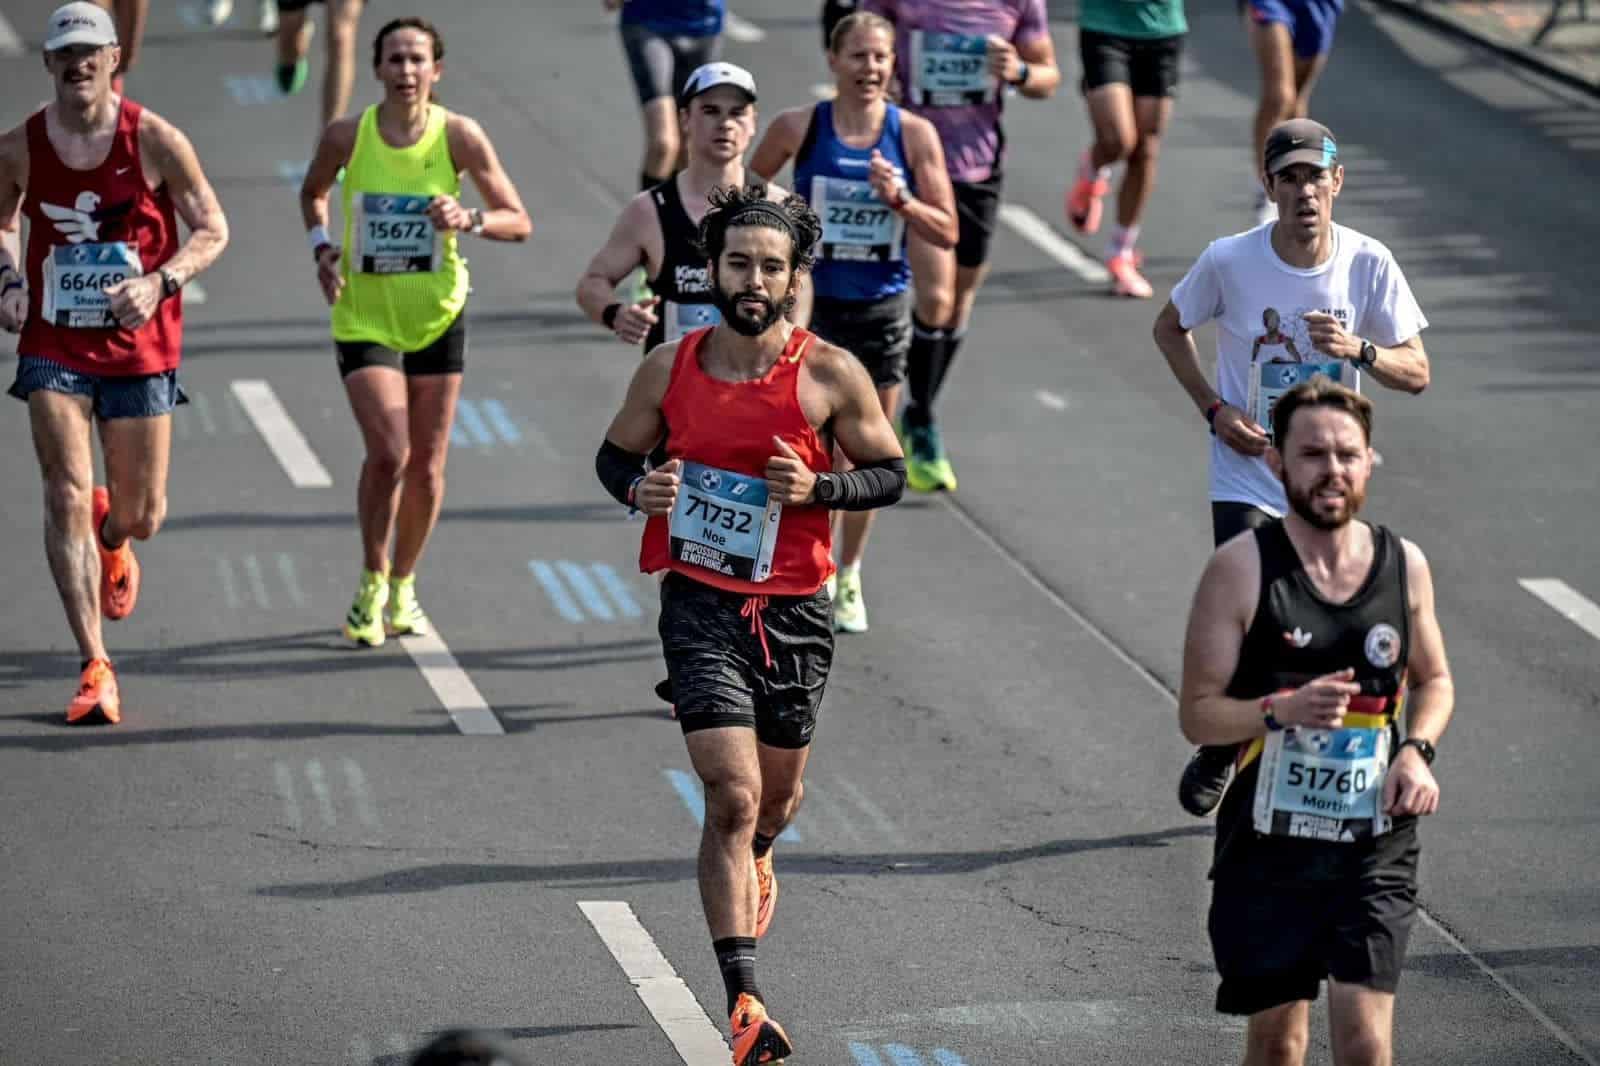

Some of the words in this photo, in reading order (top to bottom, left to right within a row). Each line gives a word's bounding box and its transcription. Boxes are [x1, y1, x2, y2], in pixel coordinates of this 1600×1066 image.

[827, 206, 890, 226] 22677
[368, 221, 428, 239] 15672
[685, 494, 753, 534] 71732
[702, 527, 727, 546] Noe
[680, 550, 690, 562] IS
[688, 552, 722, 571] NOTHING
[682, 540, 728, 563] IMPOSSIBLE
[1287, 761, 1367, 793] 51760
[1302, 794, 1352, 814] Martin
